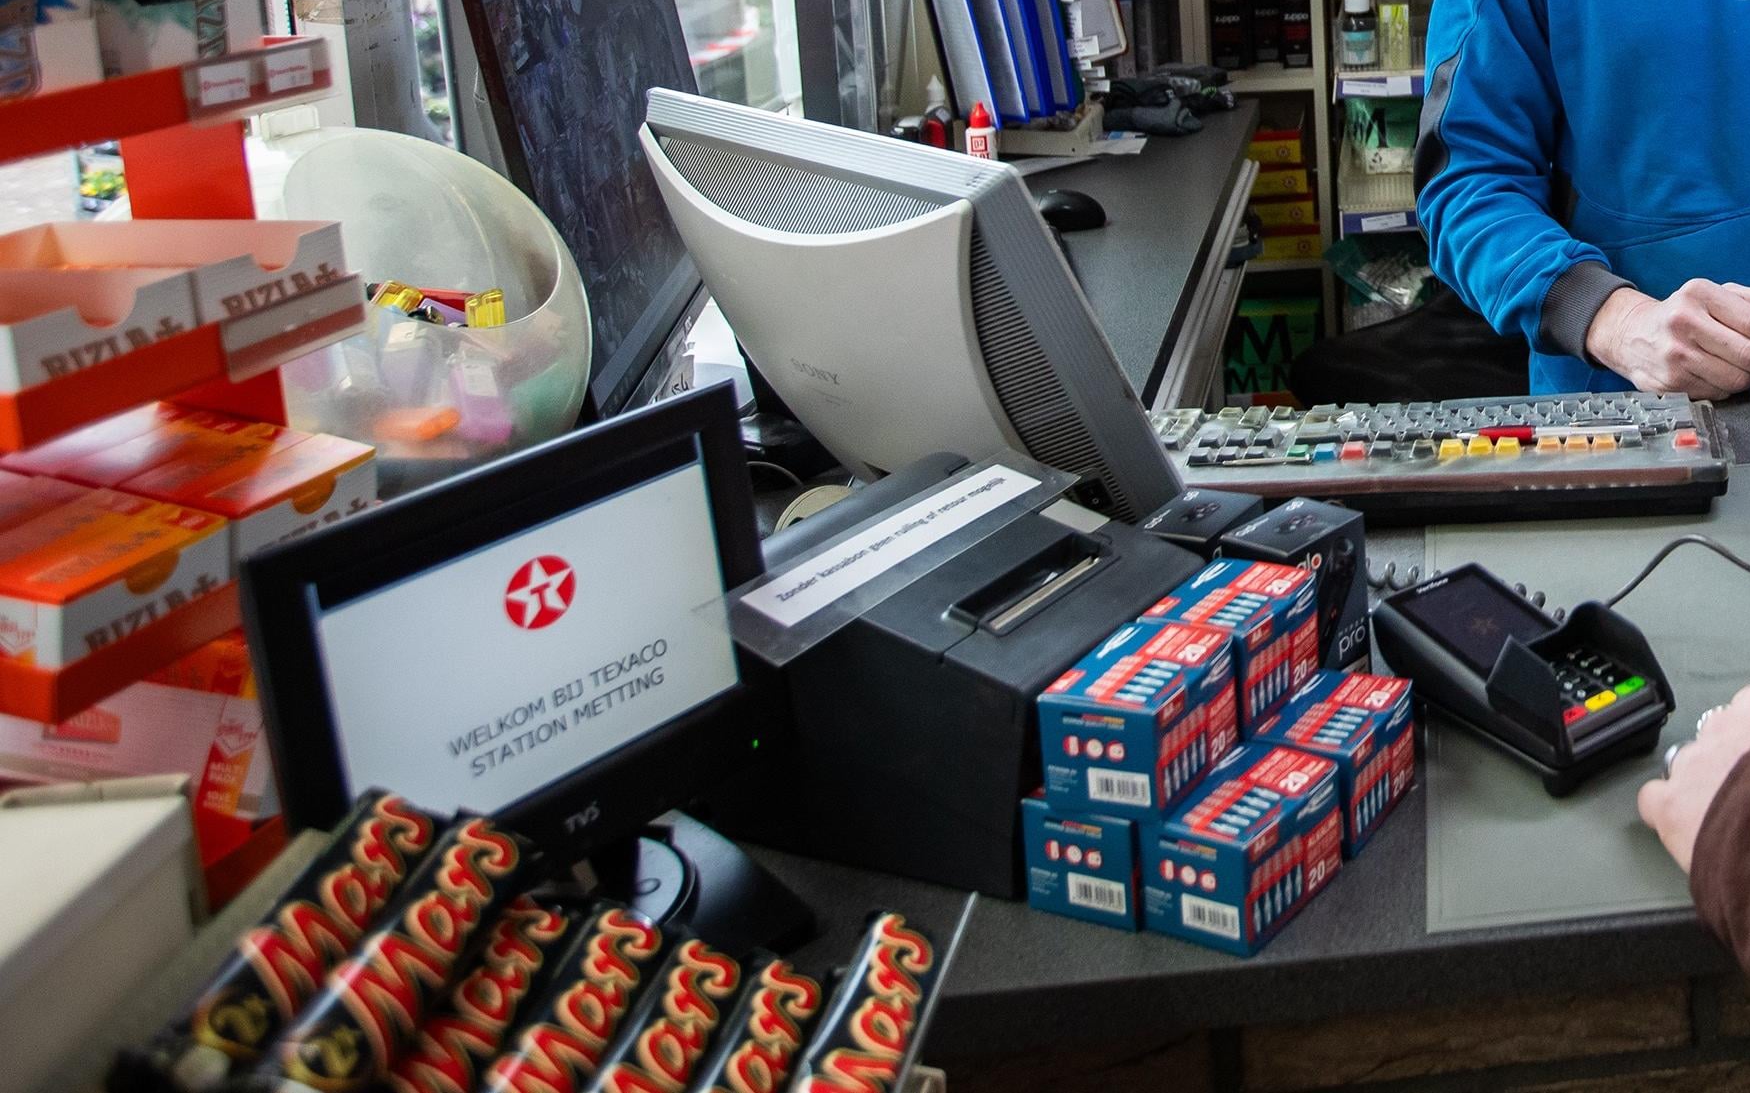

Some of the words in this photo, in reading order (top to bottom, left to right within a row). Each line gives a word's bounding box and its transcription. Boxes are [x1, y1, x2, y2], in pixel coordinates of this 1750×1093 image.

[450, 697, 547, 757] WELKOM
[552, 678, 584, 708] BIJ
[589, 639, 668, 688] TEXACO
[1339, 625, 1366, 660] pro
[471, 715, 568, 777] STATION
[573, 666, 666, 725] METTING
[238, 794, 434, 1025] Mars
[1308, 859, 1326, 891] 20
[326, 817, 520, 1078] Mars
[725, 960, 822, 1093] ars
